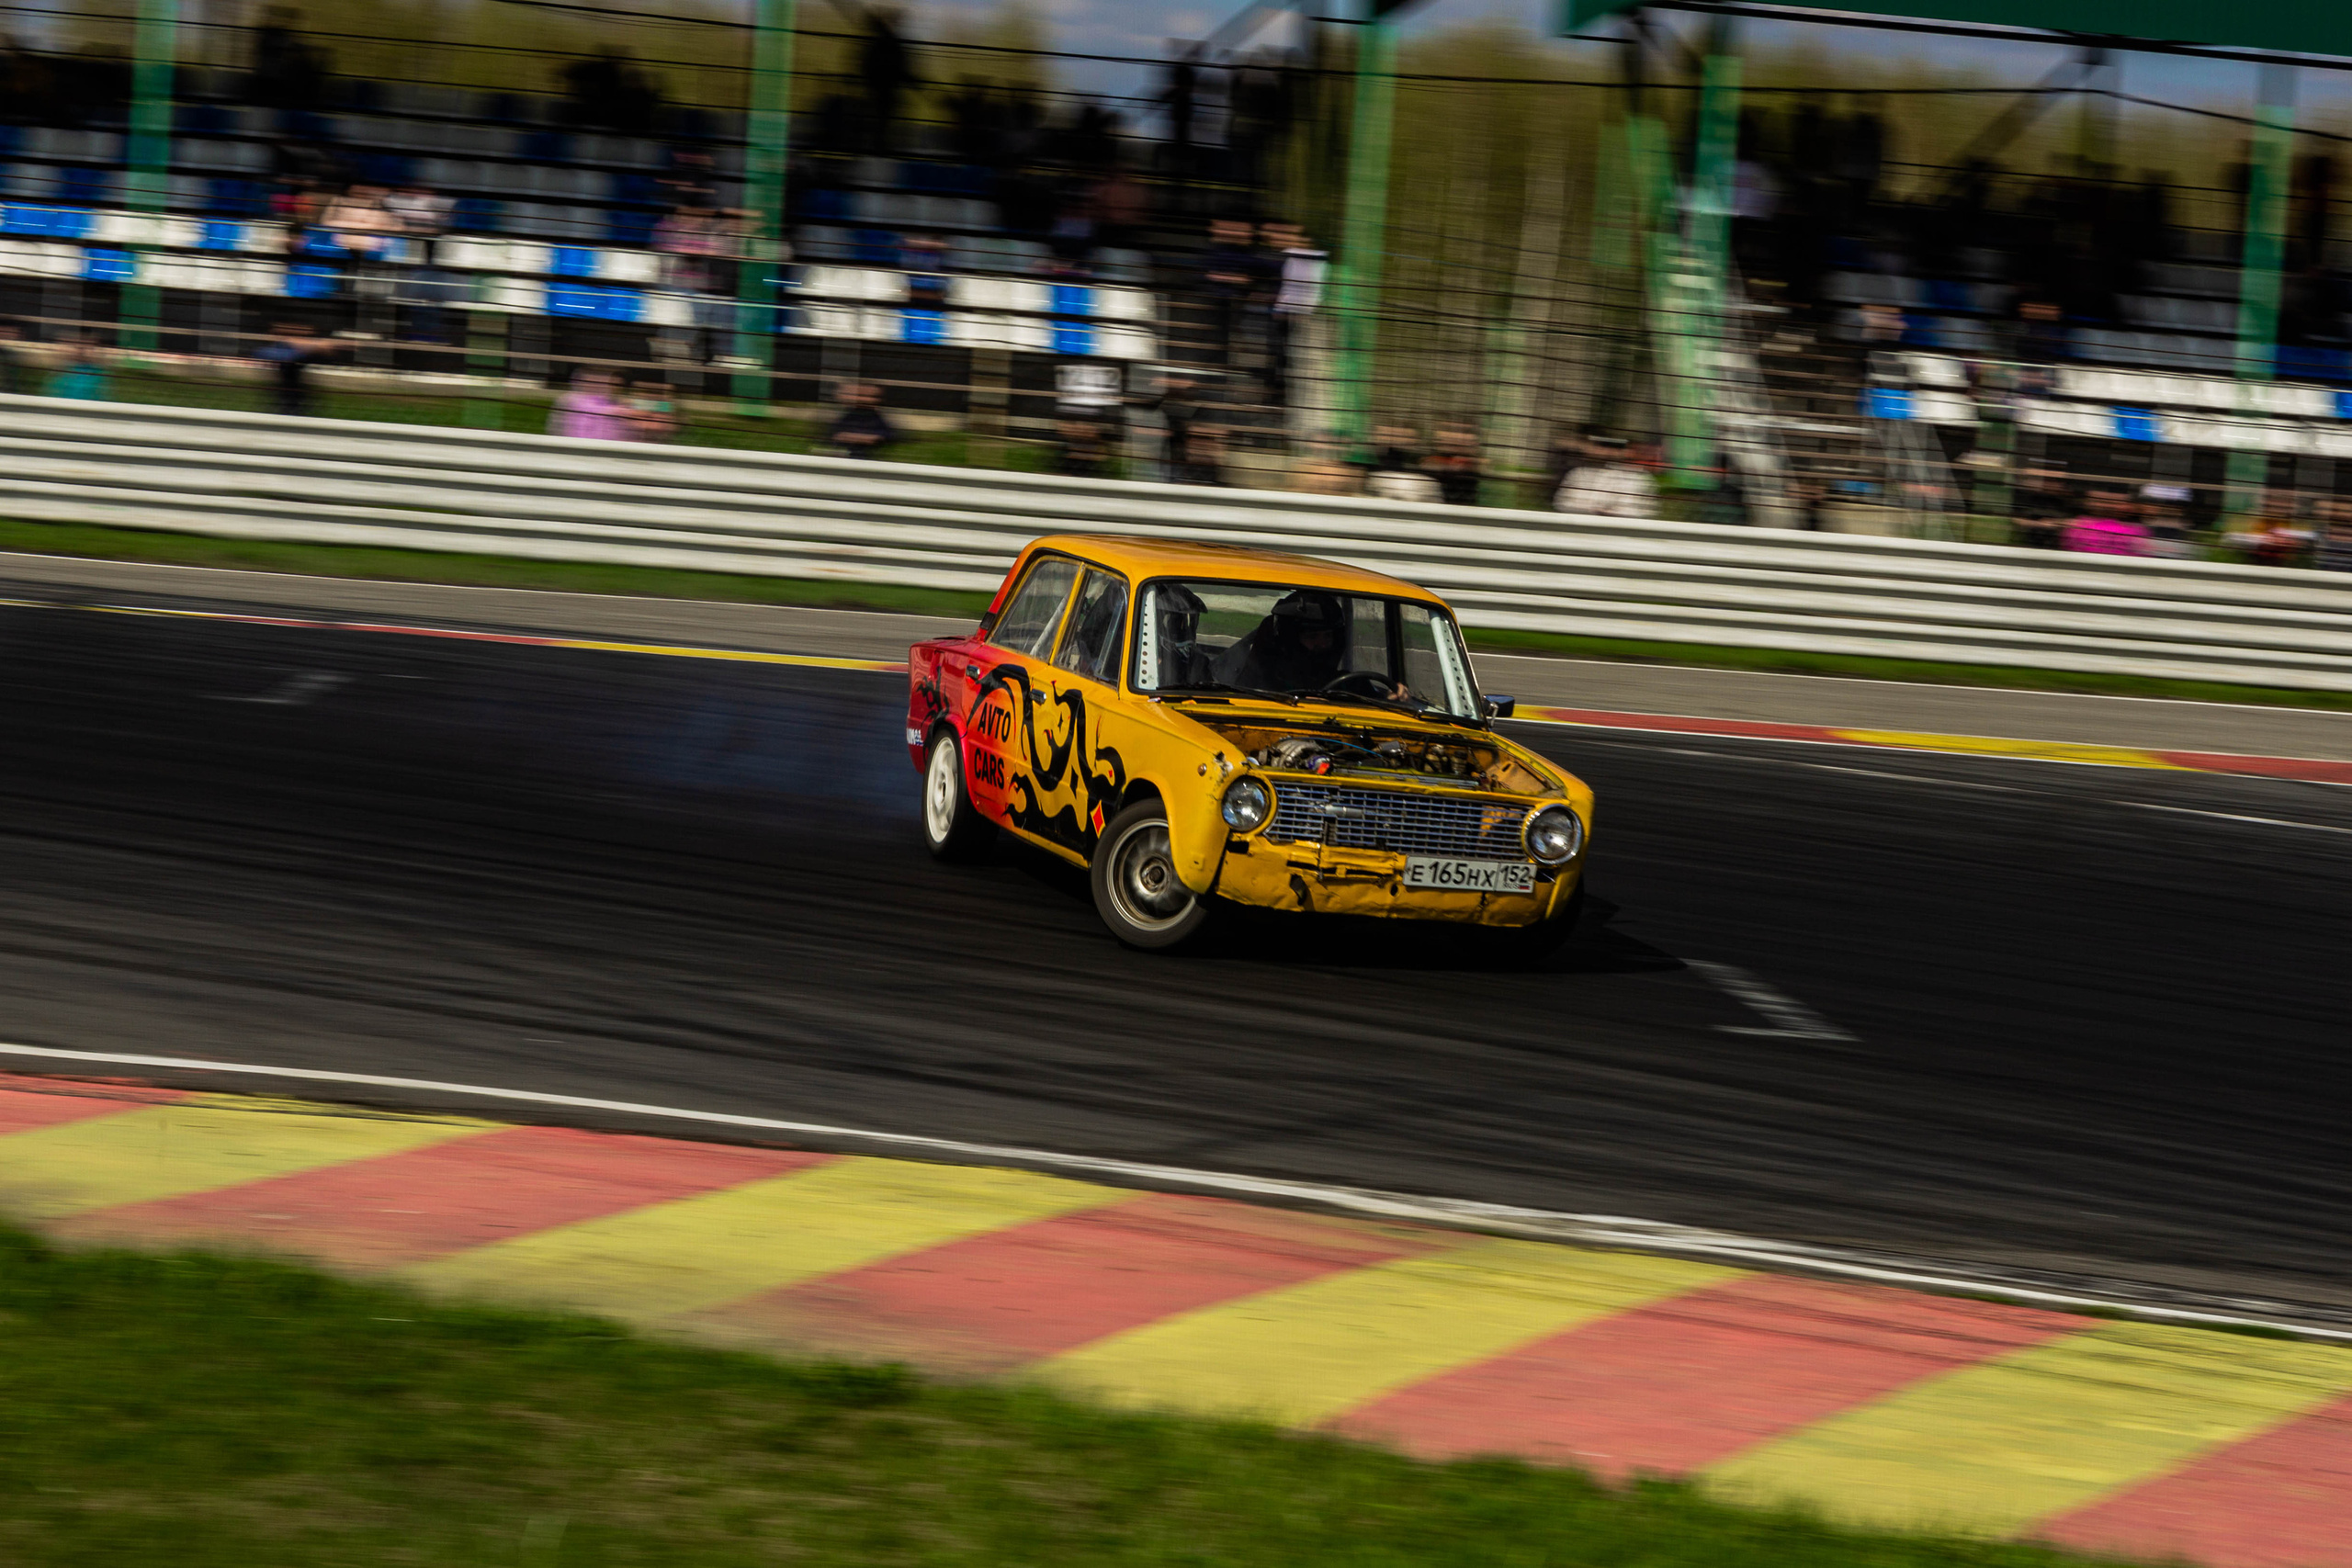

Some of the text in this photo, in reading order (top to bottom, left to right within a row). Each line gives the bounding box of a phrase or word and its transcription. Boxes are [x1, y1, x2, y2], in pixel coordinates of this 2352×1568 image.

[978, 702, 1011, 743] AVTO
[974, 748, 1004, 790] CARS
[1499, 865, 1531, 883] 152
